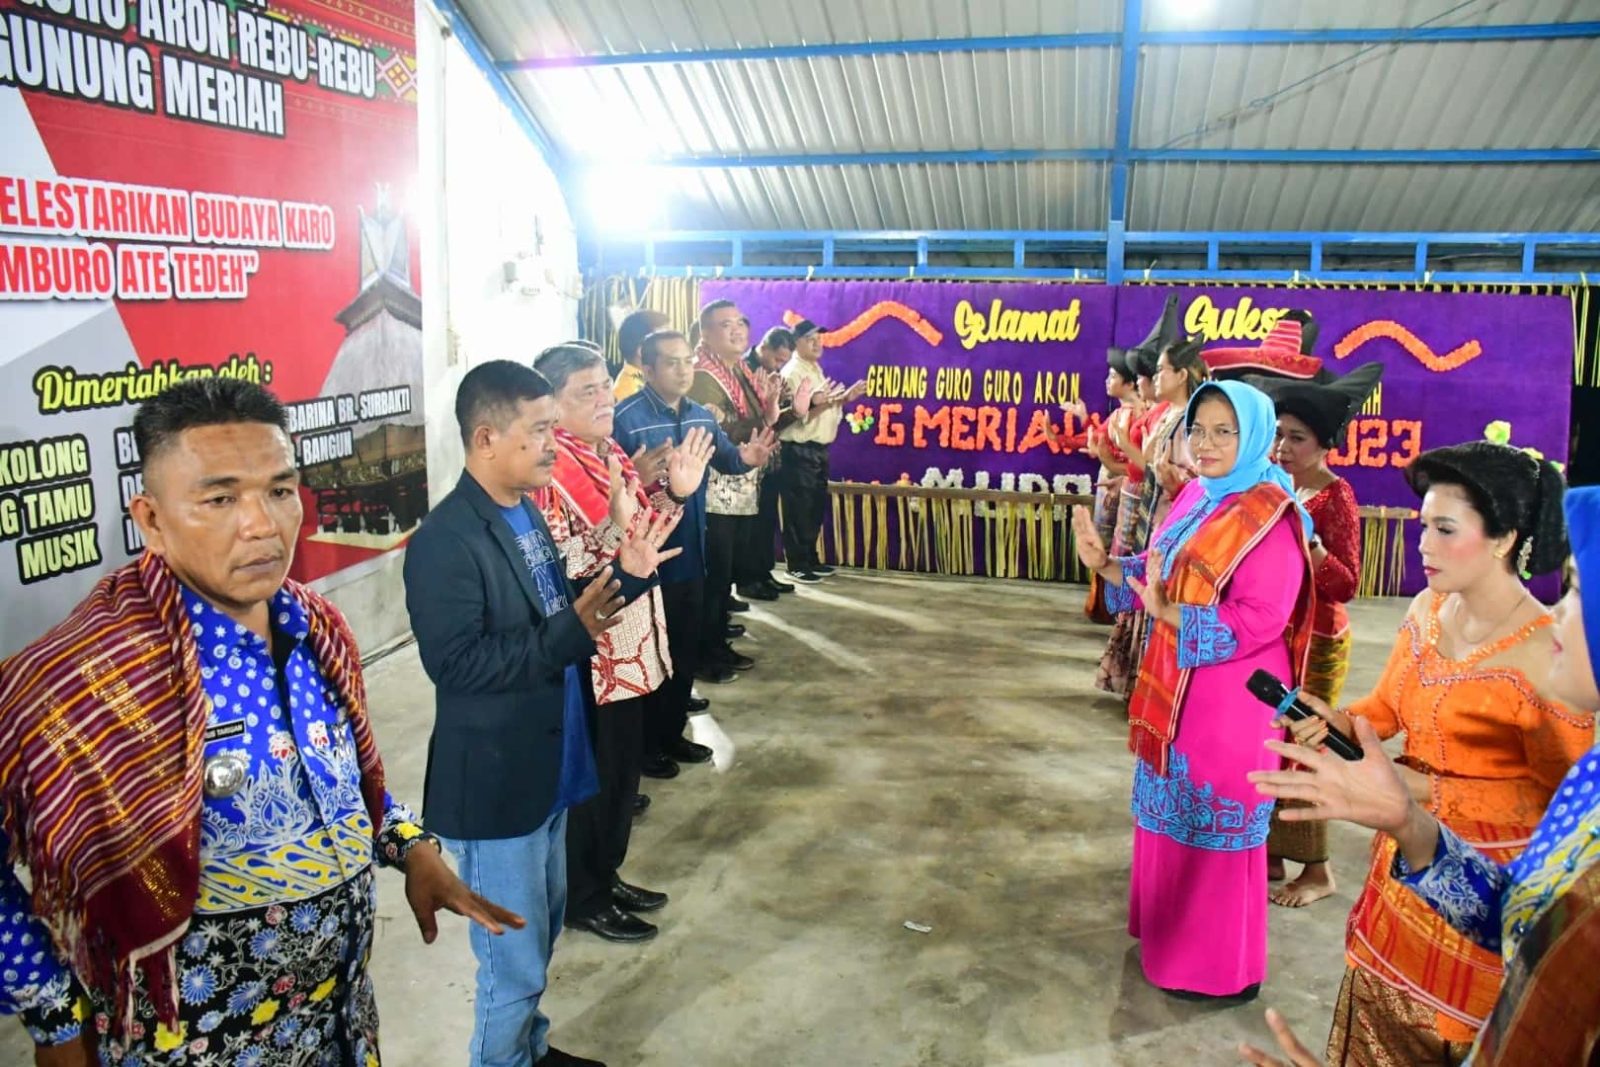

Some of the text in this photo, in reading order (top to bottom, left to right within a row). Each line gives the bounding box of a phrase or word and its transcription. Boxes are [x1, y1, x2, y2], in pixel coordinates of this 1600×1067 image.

[140, 0, 230, 60] ARON
[237, 9, 375, 98] REBU-REBU
[162, 54, 284, 135] MERIAH
[0, 175, 332, 245] ELESTARIKAN BUDAYA KARO
[0, 244, 112, 293] MBURO
[121, 249, 168, 293] ATE
[954, 294, 1312, 350] Selamat Suks
[337, 397, 358, 423] BR.
[360, 387, 411, 420] SURBAKTI
[866, 365, 1081, 405] GENDANG GURO GURO ARON
[0, 438, 88, 487] KOLONG
[302, 430, 354, 466] BANGUN
[1326, 418, 1423, 468] 023
[0, 498, 20, 536] G
[23, 482, 93, 530] TAMU
[20, 527, 99, 580] MUSIK
